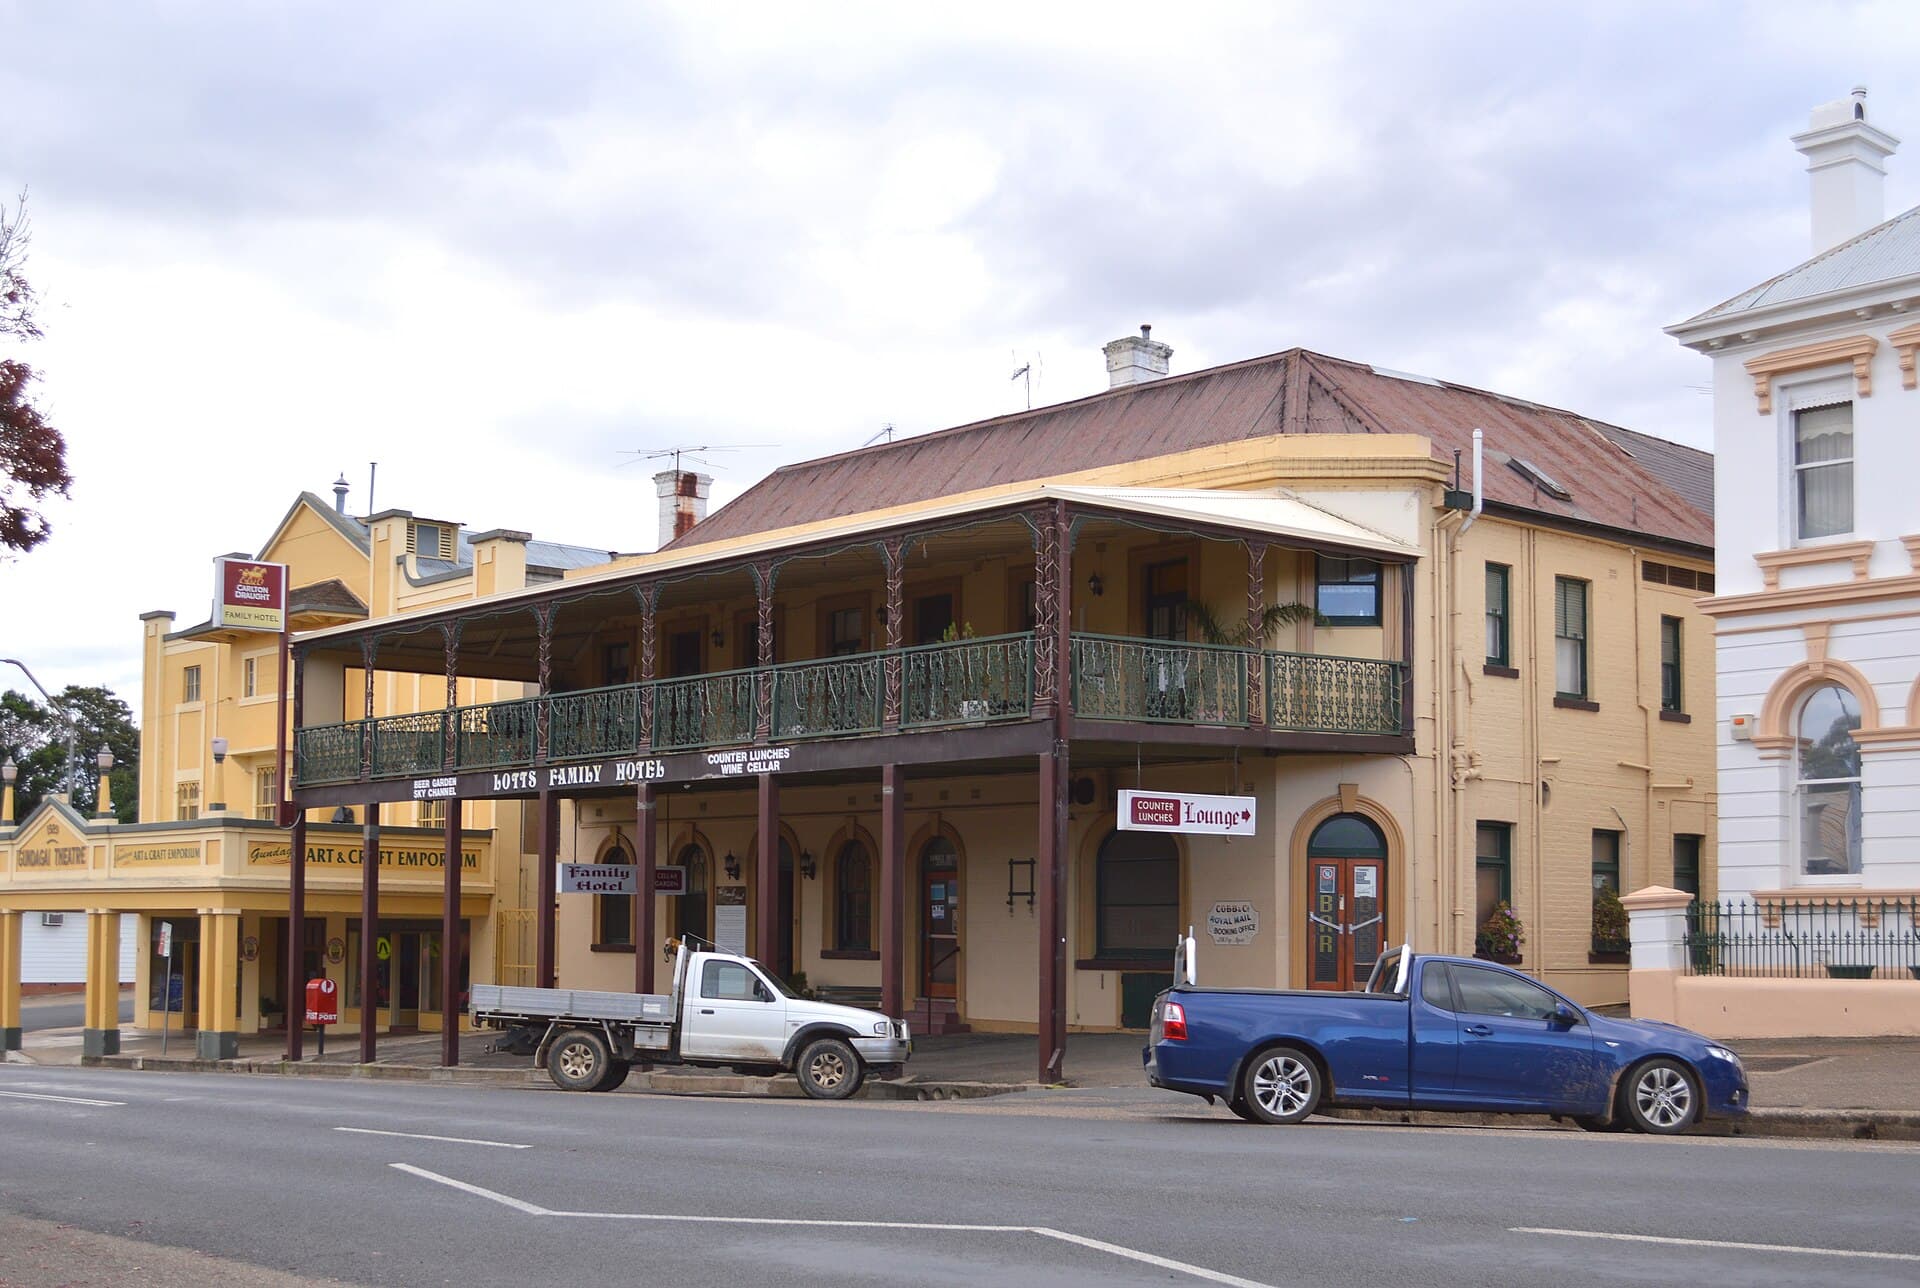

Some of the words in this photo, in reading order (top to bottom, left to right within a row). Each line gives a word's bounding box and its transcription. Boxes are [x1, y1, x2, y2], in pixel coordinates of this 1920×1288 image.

[236, 584, 269, 594] CARLTON
[235, 591, 270, 600] DRAUGHT
[225, 611, 252, 619] FAMILY
[707, 752, 747, 765] COUNTER
[749, 748, 790, 762] LUNCHES
[720, 764, 743, 774] WINE
[746, 761, 780, 773] CELLAR
[493, 770, 537, 791] LOTTS
[549, 765, 602, 786] FAMILY
[616, 760, 665, 781] HOTEL
[413, 779, 430, 789] BEER
[431, 777, 457, 788] GARDEN
[413, 789, 426, 798] SKY
[427, 788, 457, 796] CHANNEL
[1137, 801, 1175, 811] COUNTER
[1138, 813, 1174, 823] LUNCHES
[1183, 802, 1240, 829] Lounge
[17, 848, 51, 867] GUNDAGAI
[55, 846, 87, 866] THEATRE
[134, 851, 144, 860] ART
[149, 850, 166, 860] CRAFT
[168, 848, 200, 859] EMPORIUM
[306, 848, 334, 863] ART
[337, 851, 346, 864] &
[568, 865, 630, 879] Family
[576, 881, 622, 891] Hotel
[1234, 914, 1251, 923] MAIL
[1319, 895, 1333, 953] BAR
